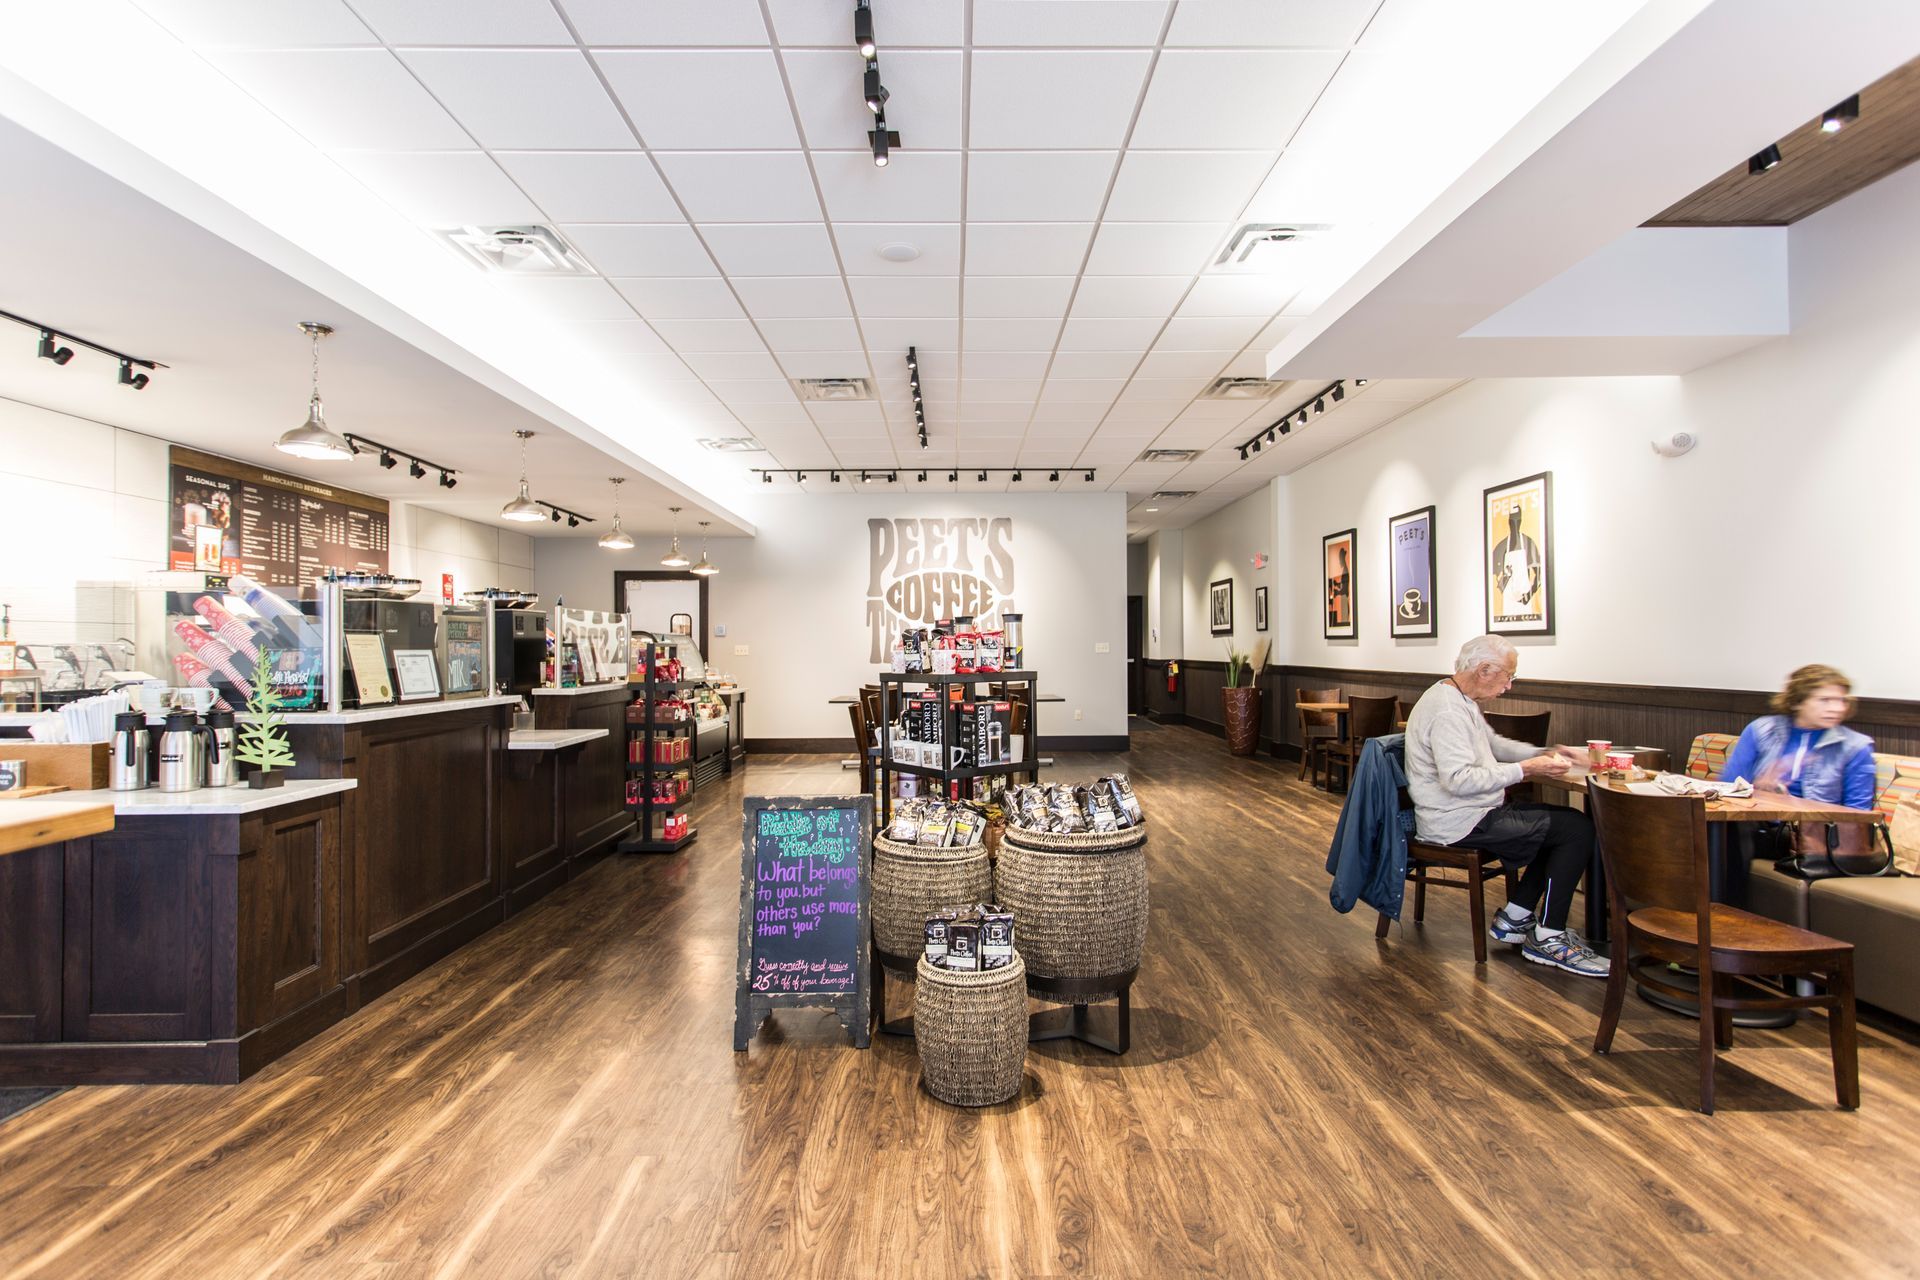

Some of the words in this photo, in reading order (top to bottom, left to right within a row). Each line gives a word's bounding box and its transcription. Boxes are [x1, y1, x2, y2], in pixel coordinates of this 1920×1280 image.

[185, 475, 217, 488] SEASONAL
[217, 481, 231, 491] SIPS
[263, 473, 303, 490] HANDCRAFTED
[1492, 491, 1539, 518] PEET'S
[1398, 527, 1425, 546] PEET'S
[866, 517, 1015, 597] PEET'S
[885, 571, 995, 624] COFFEE
[978, 705, 987, 768] CHAMBORD
[761, 811, 812, 836] Riddle
[816, 810, 840, 832] of
[778, 835, 811, 857] the
[811, 830, 851, 863] day:
[757, 858, 805, 882] What
[809, 857, 857, 889] belongs
[757, 885, 772, 901] to
[802, 884, 826, 898] but
[756, 906, 798, 922] others
[802, 901, 825, 916] use
[829, 901, 857, 914] more
[757, 923, 786, 937] than
[793, 916, 821, 939] you?
[757, 957, 778, 973] Guess
[779, 959, 809, 974] correctly
[810, 958, 827, 972] and
[781, 975, 792, 990] off
[792, 975, 801, 991] of
[800, 977, 818, 991] your
